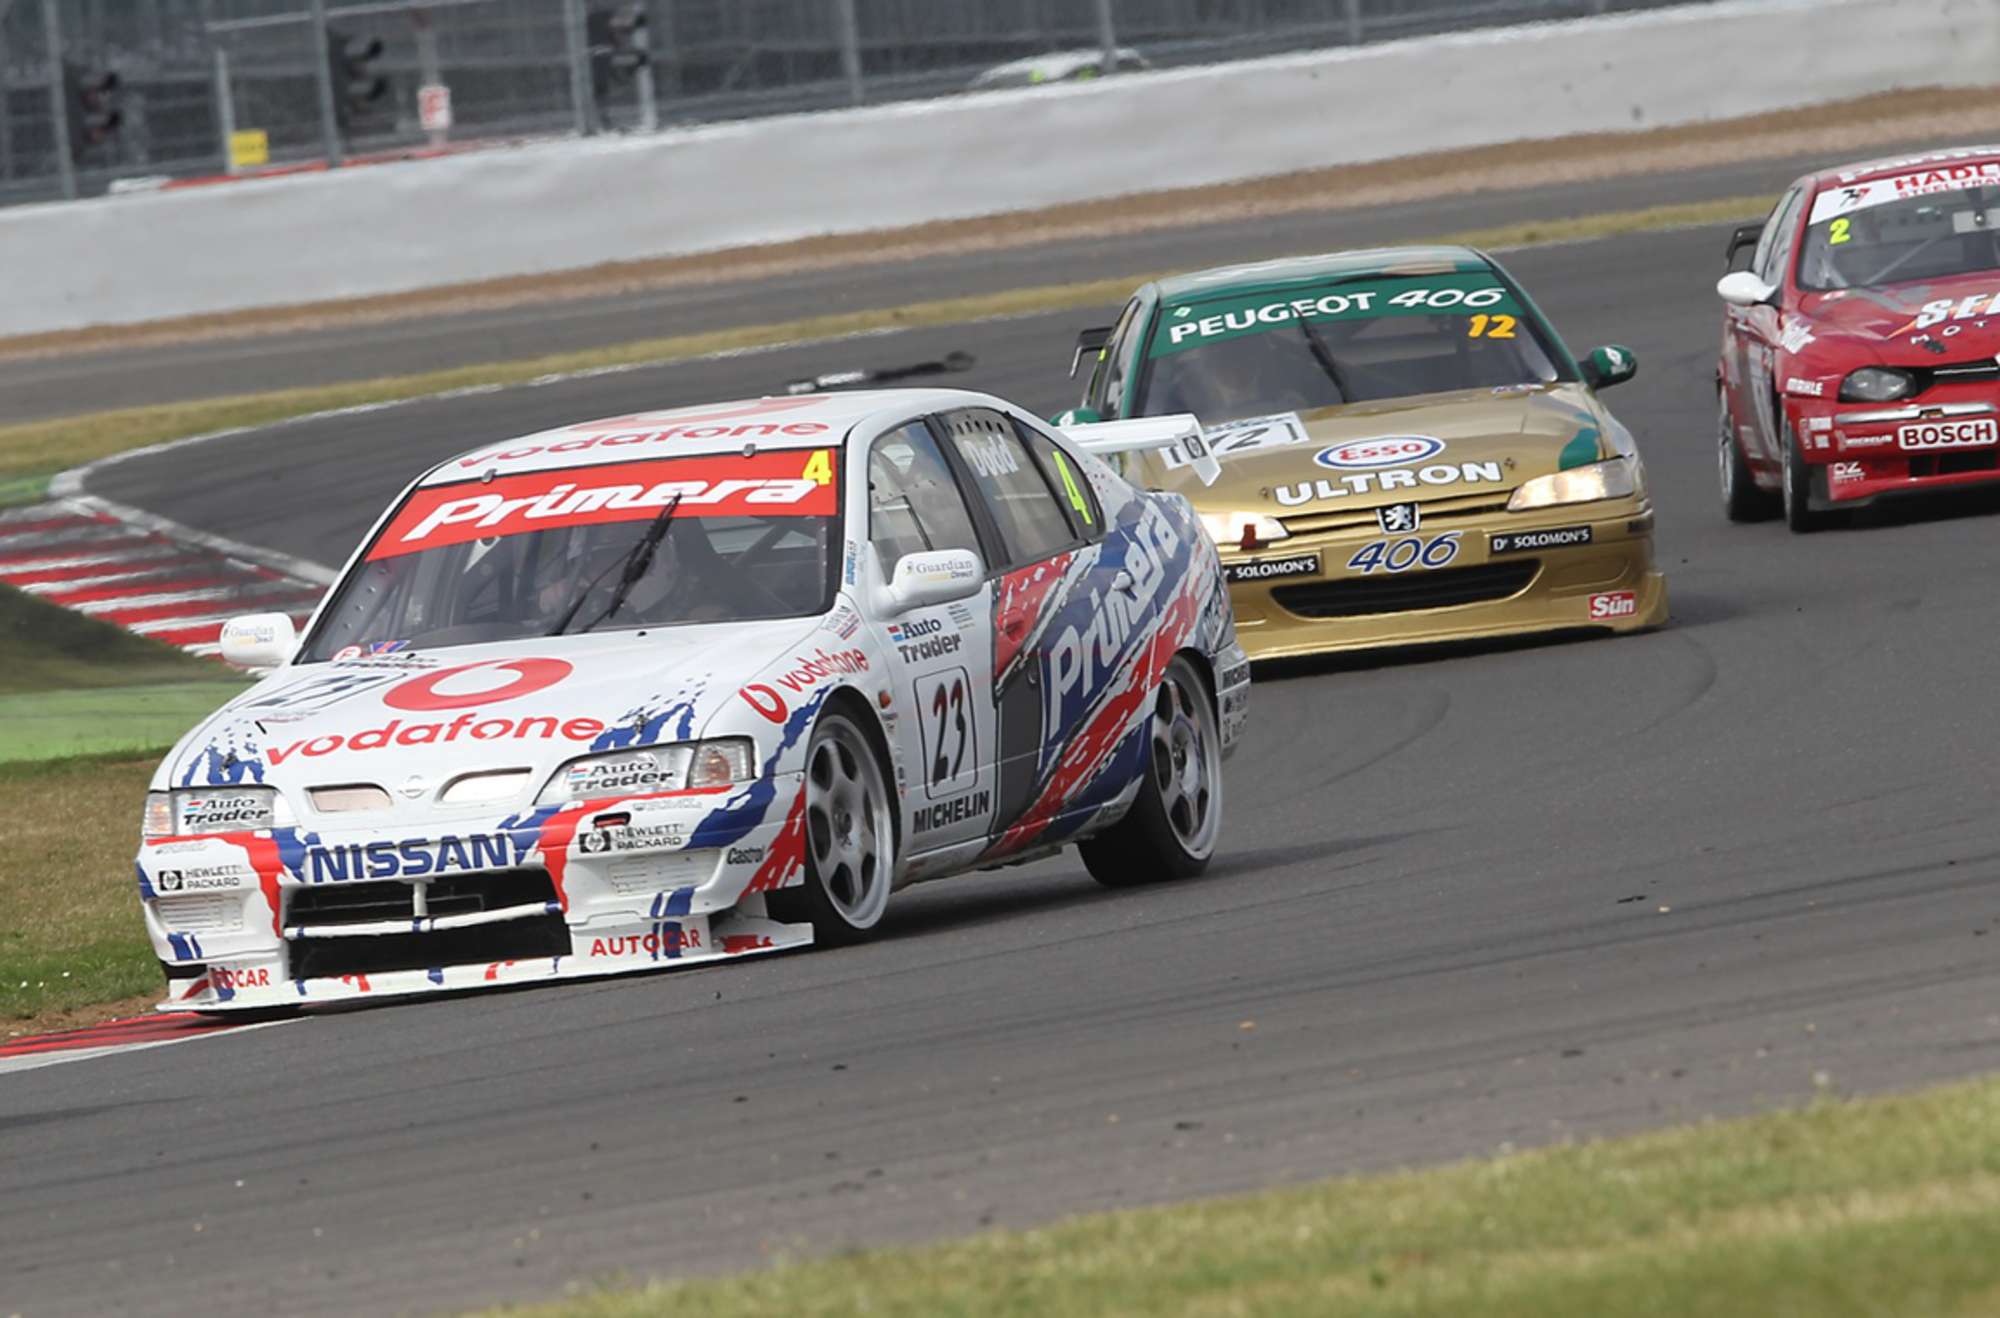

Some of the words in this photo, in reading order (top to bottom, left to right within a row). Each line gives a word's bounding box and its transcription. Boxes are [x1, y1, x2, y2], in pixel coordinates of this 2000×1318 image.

[1830, 218, 1851, 245] 2
[1169, 292, 1377, 343] PEUGEOT
[1388, 287, 1506, 308] 406
[1467, 315, 1516, 338] 12
[459, 420, 831, 468] vodafone
[1903, 422, 1993, 447] BOSCH
[801, 449, 833, 486] 4
[963, 434, 1019, 477] Dodd
[1052, 449, 1092, 525] 4
[1274, 461, 1502, 506] ULTRON
[400, 478, 819, 543] Primera
[1347, 530, 1463, 575] 406
[1514, 529, 1590, 549] SOLOMON'S
[915, 561, 973, 574] Guardian
[1236, 557, 1316, 579] SOLOMON'S
[899, 618, 942, 639] Auto
[1050, 500, 1179, 741] Primera
[897, 633, 962, 664] Trader
[776, 647, 869, 692] vodafone
[265, 712, 605, 767] vodafone
[932, 677, 966, 787] 23
[569, 771, 674, 792] Trader
[586, 760, 655, 778] Auto
[183, 808, 269, 826] Trader
[200, 797, 256, 810] Auto
[912, 790, 990, 834] MICHELIN
[615, 822, 683, 838] HEWLETT
[616, 836, 682, 850] PACKARD
[185, 864, 240, 879] HEWLETT
[310, 833, 509, 884] NISSAN
[187, 876, 241, 889] PACKARD
[590, 929, 702, 957] AUTOCAR
